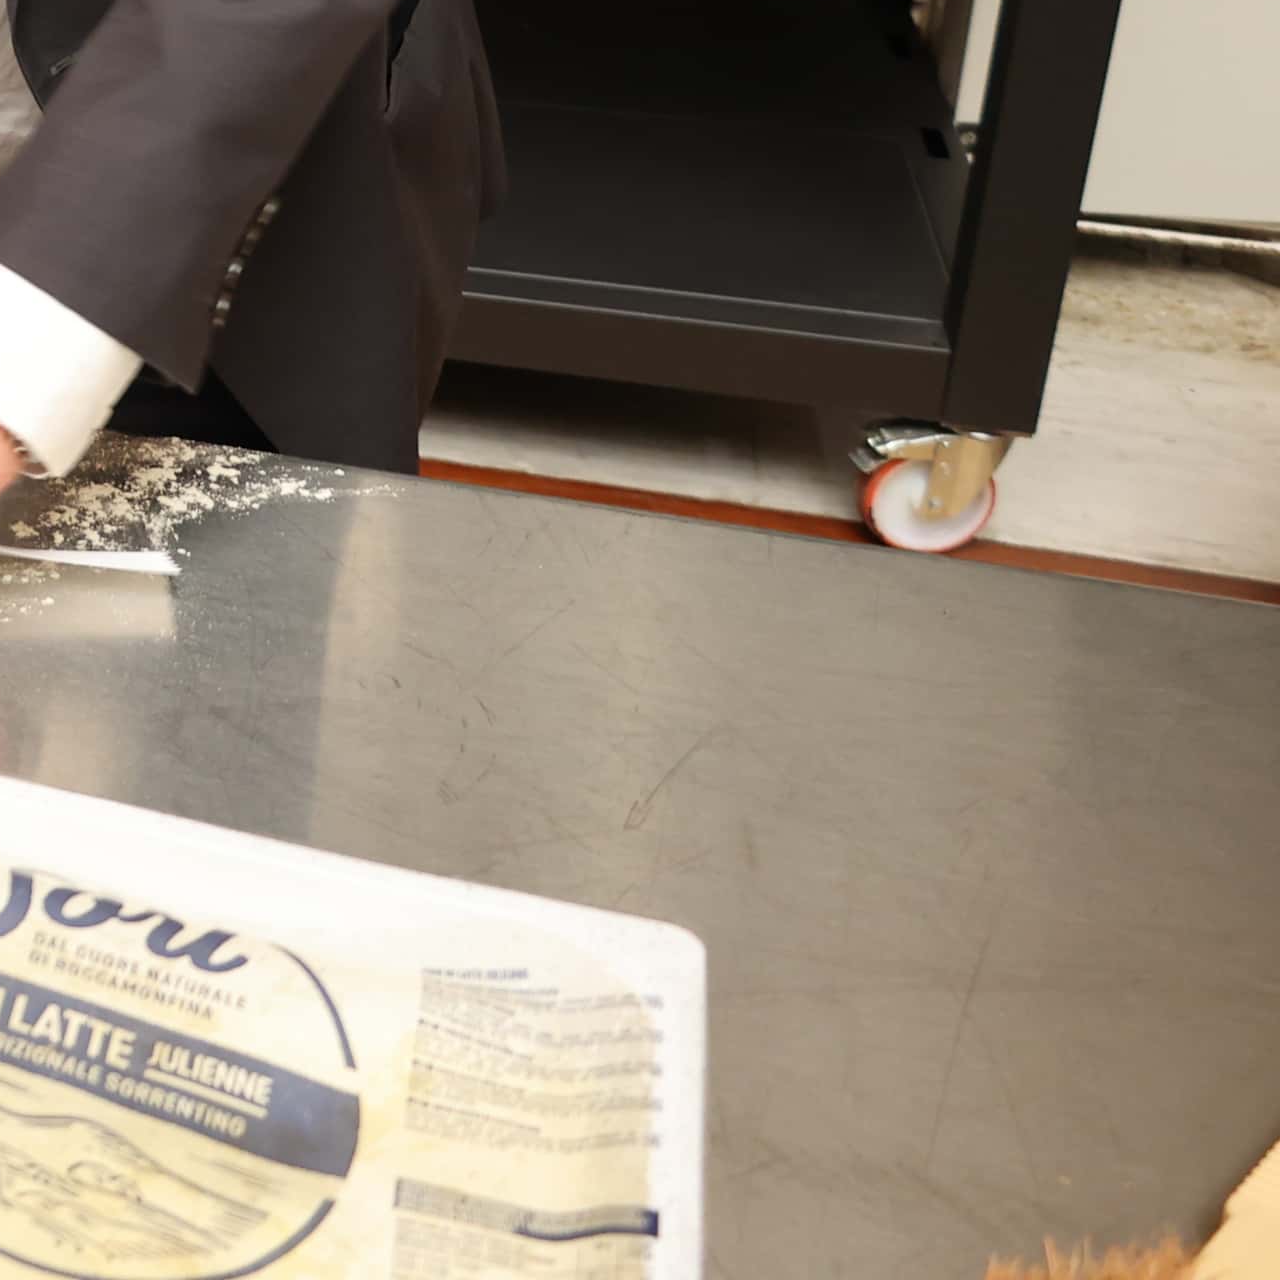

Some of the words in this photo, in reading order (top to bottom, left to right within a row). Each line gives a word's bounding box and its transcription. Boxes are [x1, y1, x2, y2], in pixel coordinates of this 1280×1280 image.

[7, 992, 137, 1071] LATTE
[148, 1039, 275, 1108] JULIENNE
[105, 1071, 249, 1139] SORRENTINO
